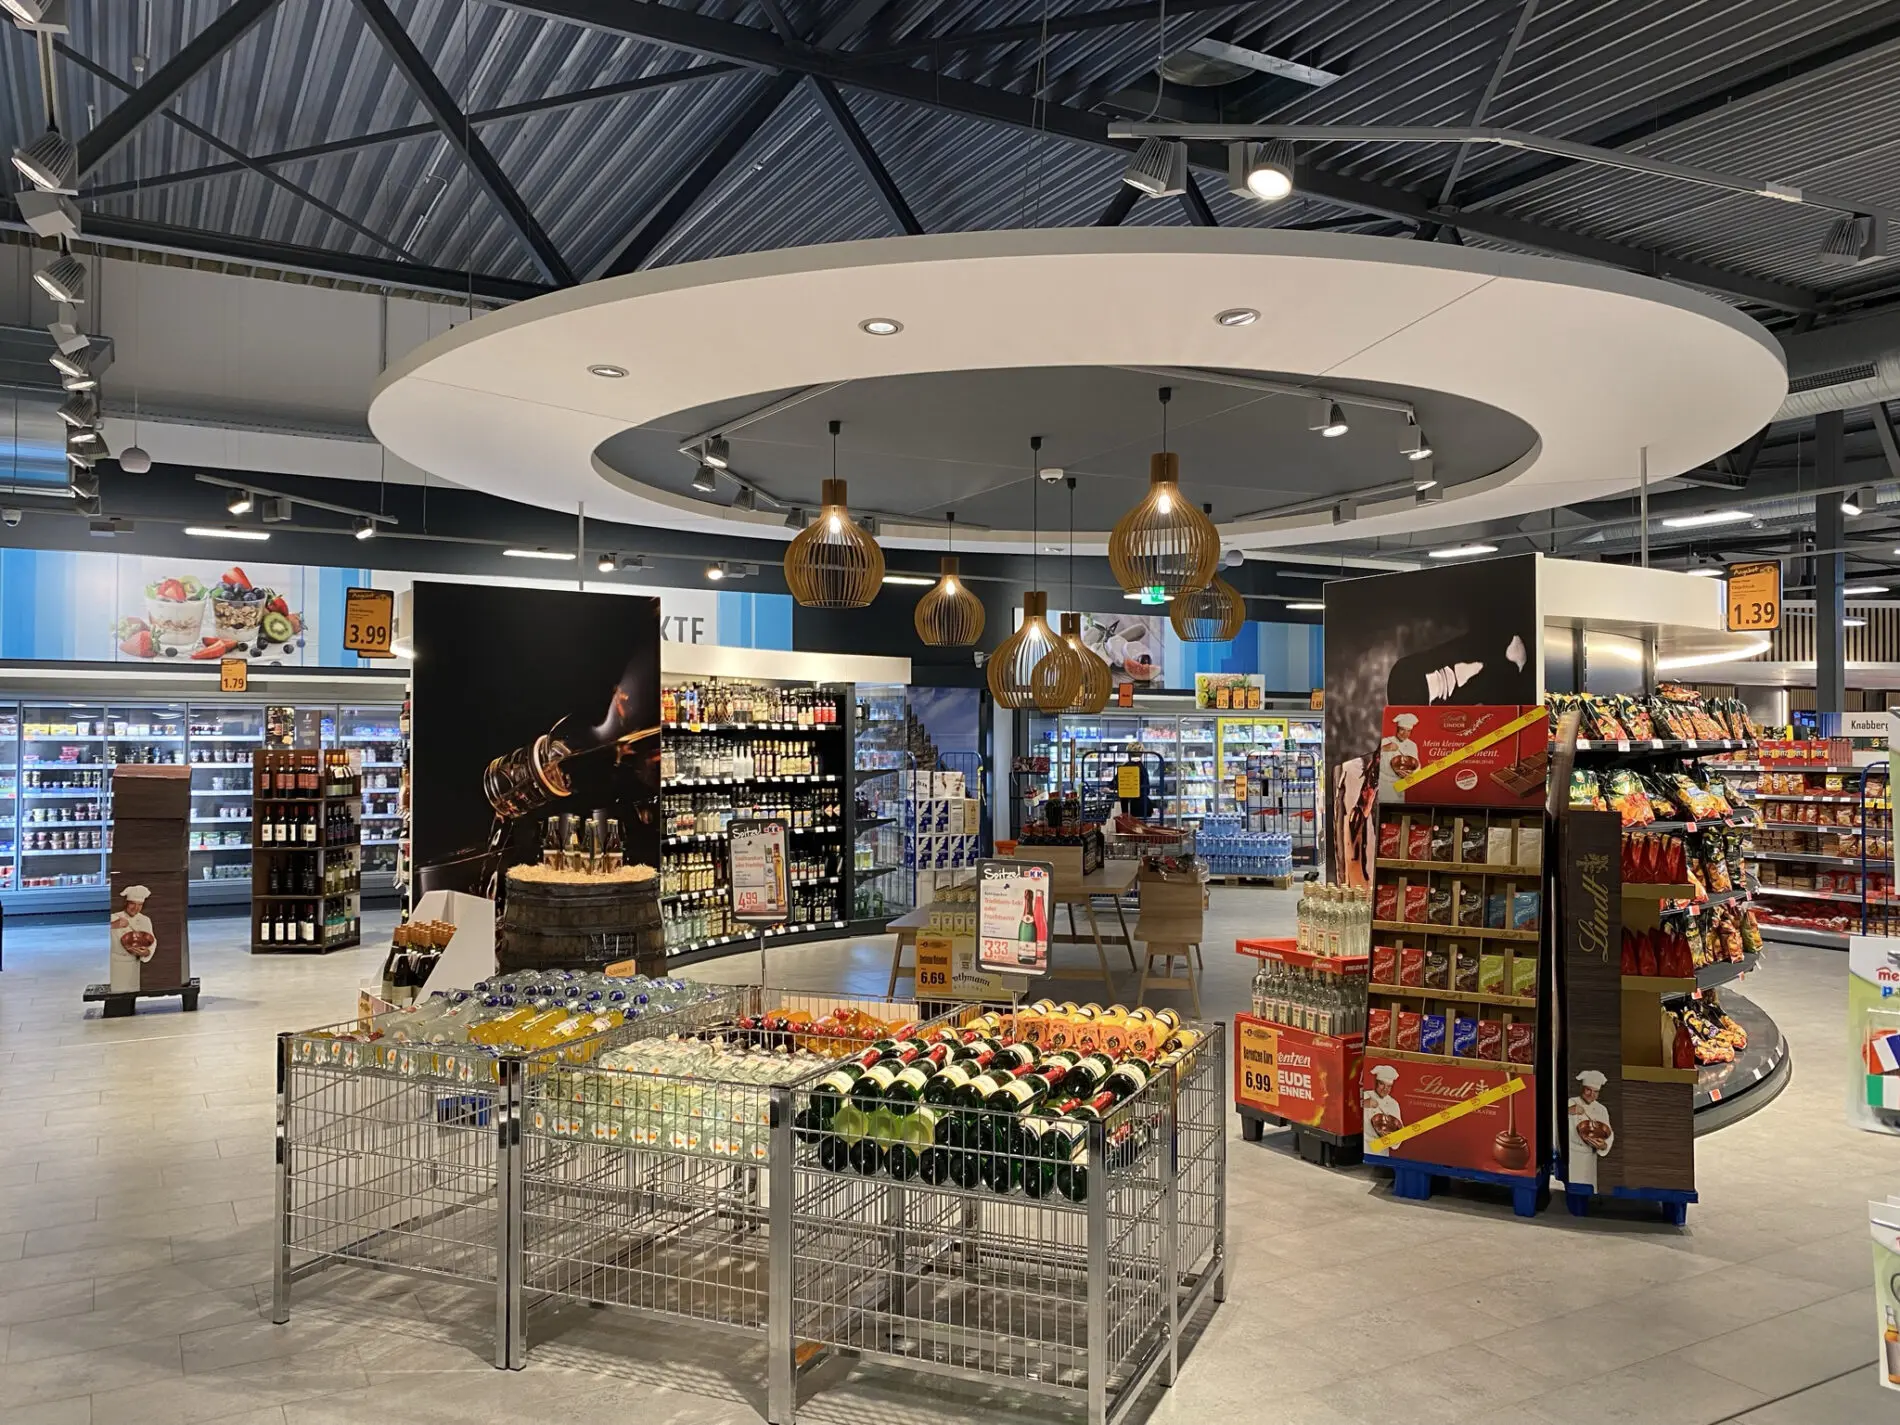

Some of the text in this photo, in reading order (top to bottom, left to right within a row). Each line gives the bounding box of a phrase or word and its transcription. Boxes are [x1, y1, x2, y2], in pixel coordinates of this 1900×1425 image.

[1734, 601, 1775, 625] 1.39
[349, 623, 386, 645] 3.99
[223, 678, 244, 689] 1.79
[1423, 739, 1467, 749] Mein kleiner
[1578, 872, 1608, 962] Lindt
[1414, 1074, 1475, 1099] Lindt
